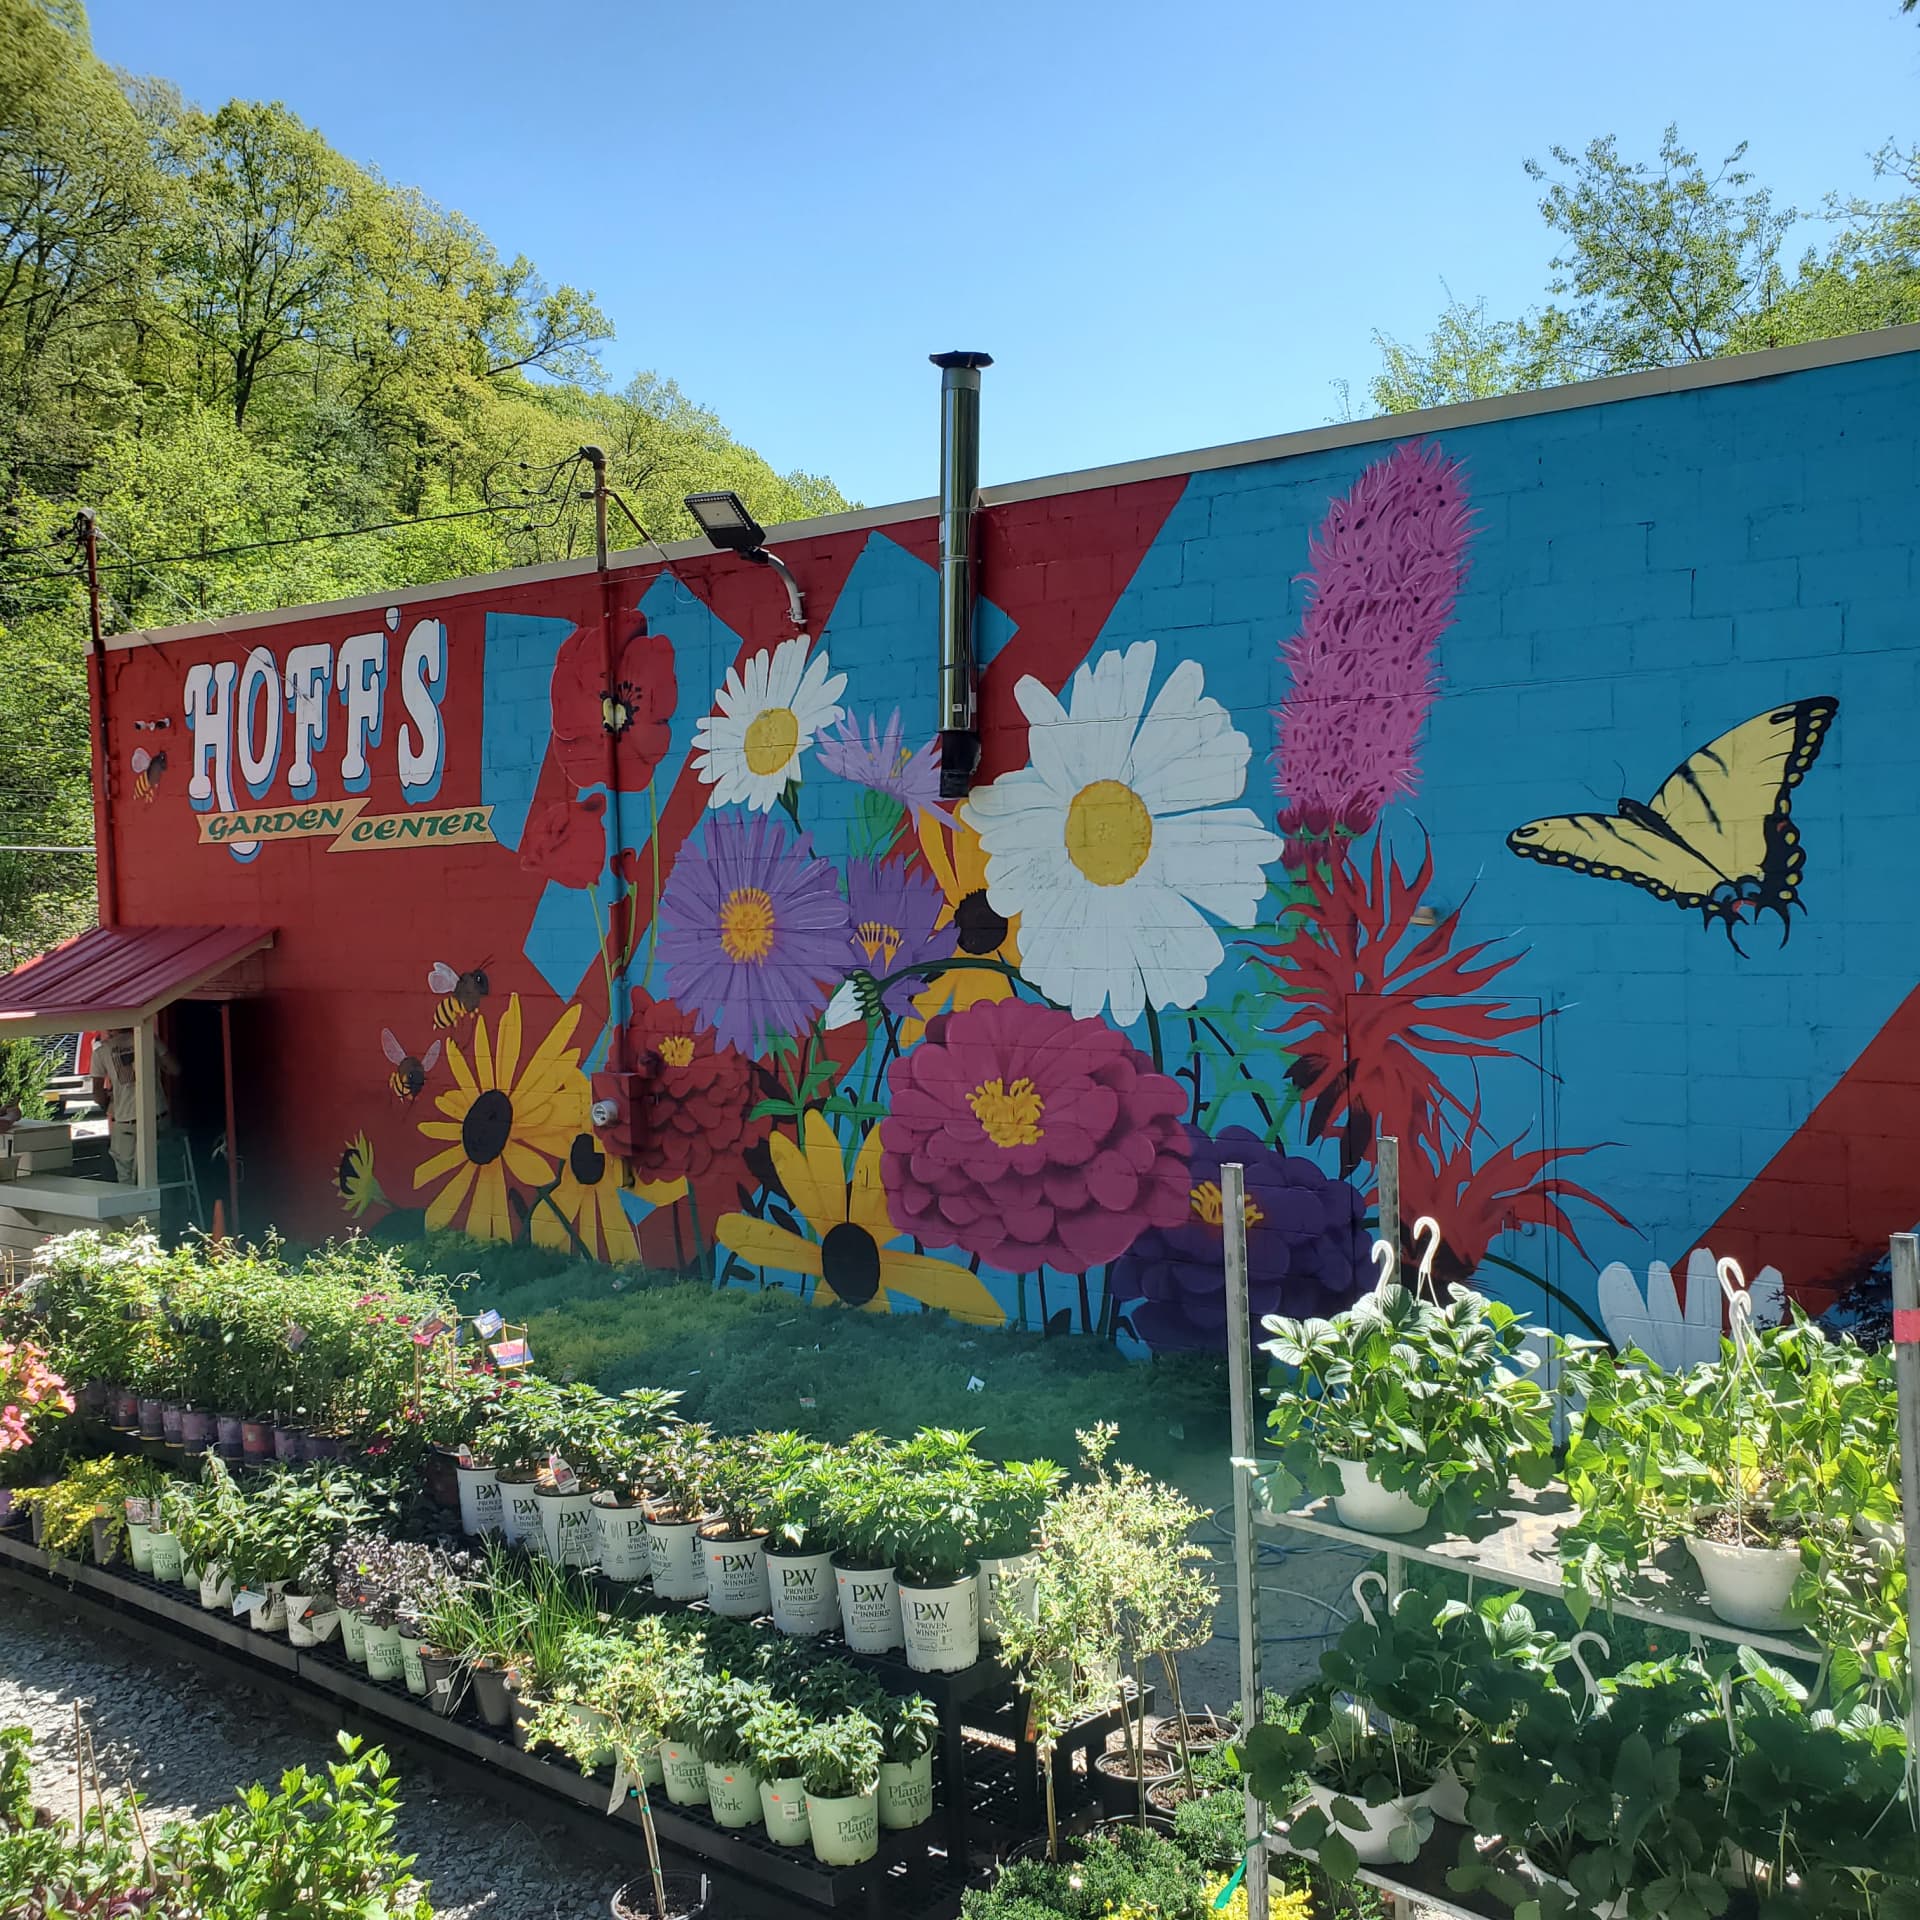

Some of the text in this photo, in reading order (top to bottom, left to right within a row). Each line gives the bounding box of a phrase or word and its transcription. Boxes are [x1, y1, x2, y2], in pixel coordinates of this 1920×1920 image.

[184, 607, 447, 854] HOFF'S
[208, 807, 487, 842] GARDEN CENTER
[559, 1509, 592, 1528] PW
[721, 1552, 757, 1572] PW
[783, 1568, 817, 1587] PW
[784, 1593, 819, 1601] WINNERS
[852, 1583, 888, 1602] PW
[855, 1603, 885, 1611] PROVEN
[912, 1602, 950, 1620] PW
[917, 1621, 947, 1629] PROVEN
[888, 1784, 924, 1799] Plants
[838, 1817, 873, 1834] Plants
